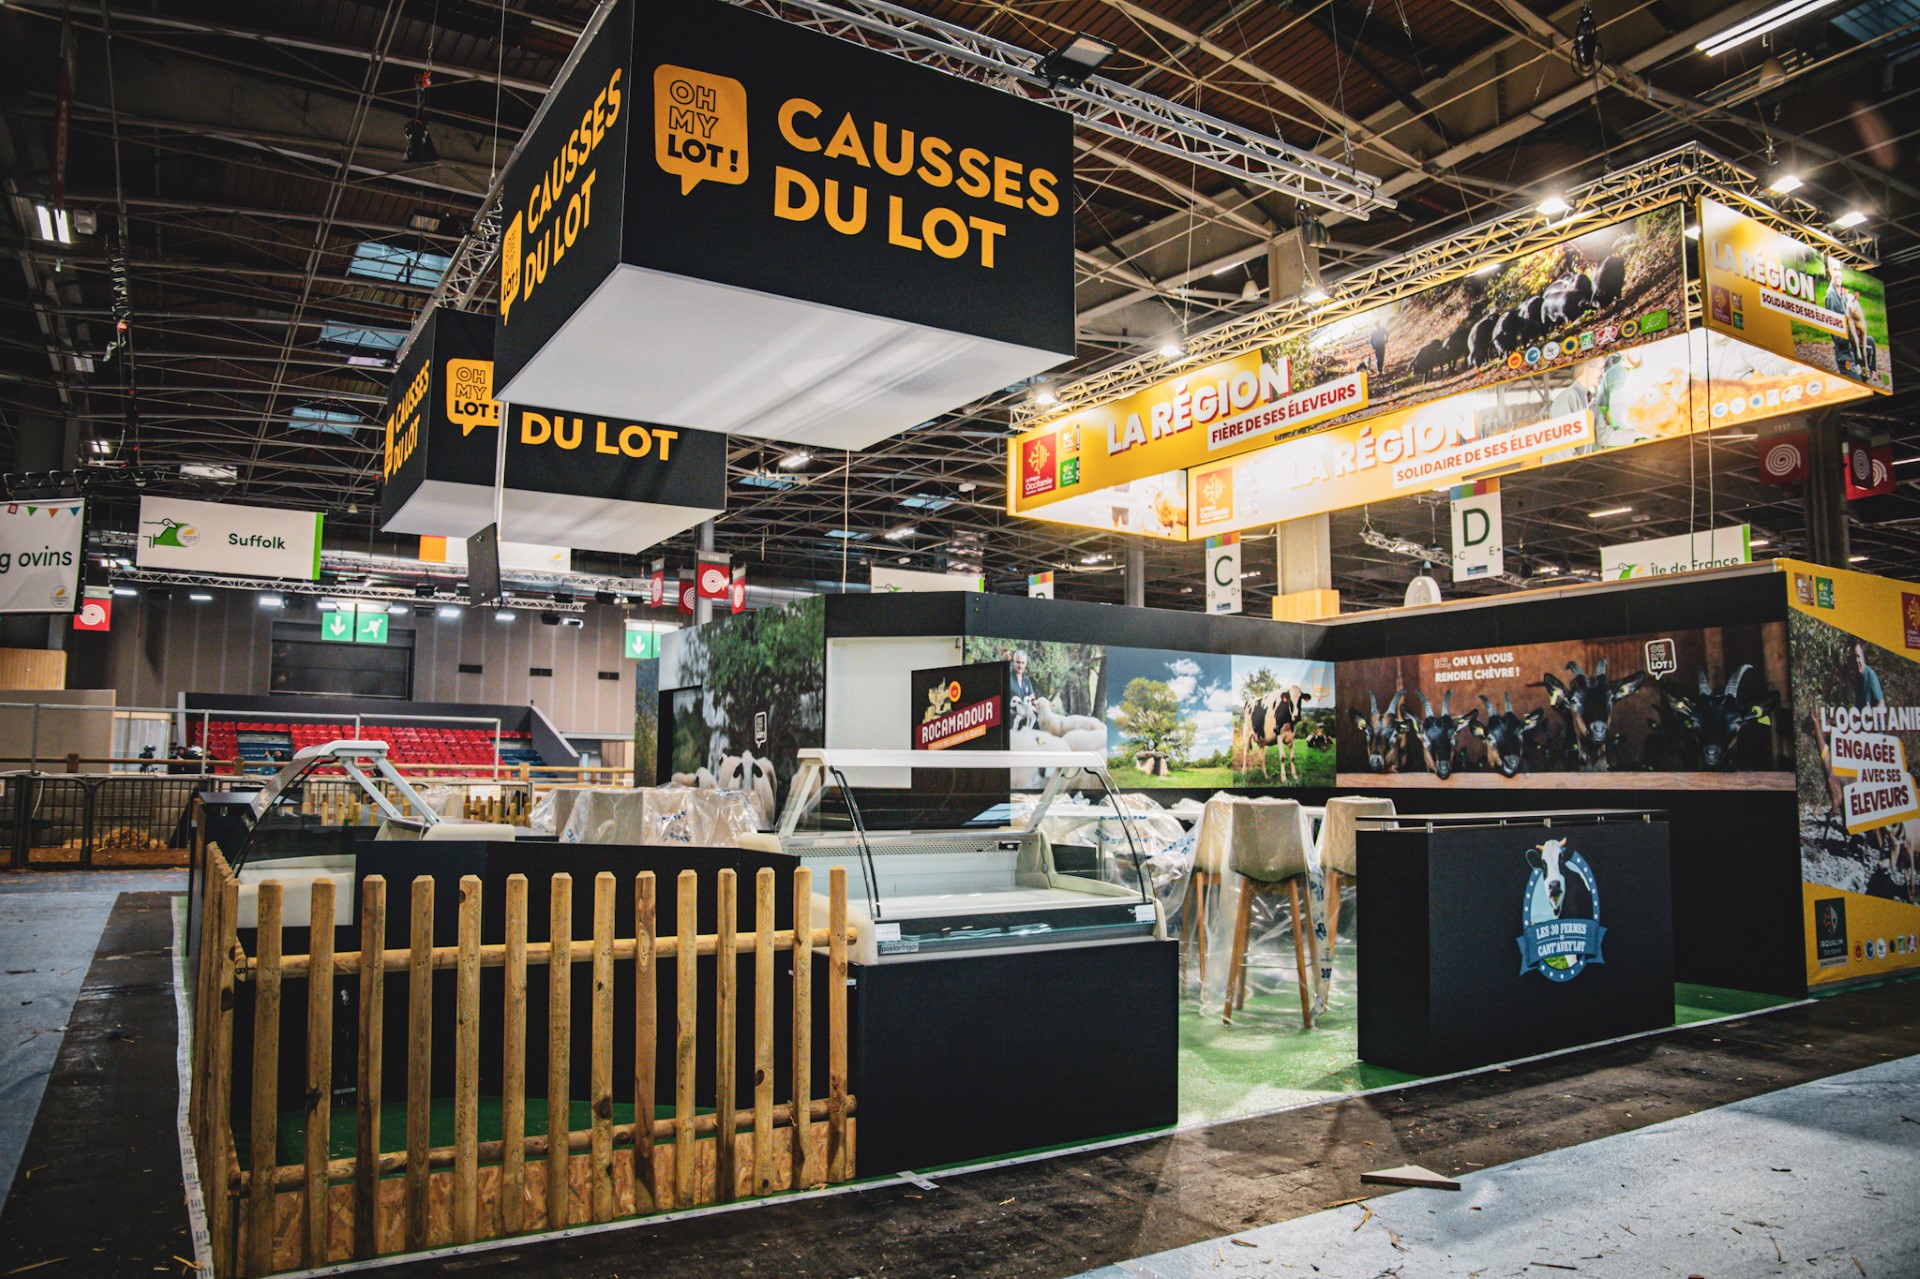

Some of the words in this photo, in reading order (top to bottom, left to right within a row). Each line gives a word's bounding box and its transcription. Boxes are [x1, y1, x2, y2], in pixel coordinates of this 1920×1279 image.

[670, 80, 716, 112] OH
[669, 105, 719, 139] MY
[527, 68, 623, 234] CAUSSES
[777, 97, 1060, 217] CAUSSES
[774, 166, 868, 235] DU
[888, 196, 1007, 269] LOT
[524, 229, 551, 302] DU
[553, 168, 597, 266] LOT
[1711, 239, 1740, 276] LA
[1740, 246, 1816, 304] RÉGION
[1762, 293, 1795, 316] SOLIDAIRE
[1795, 305, 1804, 317] DE
[1803, 307, 1815, 319] SES
[1815, 308, 1844, 329] ÉLEVEURS
[455, 383, 487, 401] MY
[456, 366, 486, 384] OH
[395, 359, 430, 433] CAUSSES
[1107, 412, 1148, 456] LA
[1151, 356, 1291, 440] RÉGION
[1212, 422, 1243, 444] FIÈRE
[1246, 418, 1261, 432] DE
[1263, 410, 1286, 428] SES
[1288, 383, 1356, 418] ÉLEVEURS
[392, 436, 405, 476] DU
[404, 413, 420, 462] LOT
[520, 411, 583, 450] DU
[596, 421, 678, 461] LOT
[1334, 406, 1478, 477] RÉGION
[1397, 457, 1463, 482] SOLIDAIRE
[1464, 449, 1482, 463] DE
[1484, 441, 1508, 458] SES
[1510, 420, 1583, 450] ÉLEVEURS
[228, 533, 286, 550] Suffolk
[1463, 508, 1490, 547] D
[18, 545, 72, 567] ovins
[1459, 551, 1466, 560] C
[1489, 546, 1495, 556] E
[1650, 563, 1667, 576] Île
[1670, 562, 1687, 573] de
[1692, 557, 1739, 571] France
[1214, 555, 1233, 587] C
[1435, 669, 1472, 683] RENDRE
[1474, 665, 1515, 680] CHÈVRE
[1452, 655, 1467, 667] ON
[1469, 654, 1483, 666] VA
[1485, 652, 1514, 664] VOUS
[922, 701, 993, 744] ROCAMADOUR
[1836, 737, 1896, 764] ENGAGÉE
[1862, 769, 1885, 782] AVEC
[1887, 769, 1902, 782] SES
[1850, 785, 1909, 816] ÉLEVEURS
[1536, 925, 1549, 939] LES
[1551, 924, 1559, 935] 30
[1560, 923, 1587, 934] FERMES
